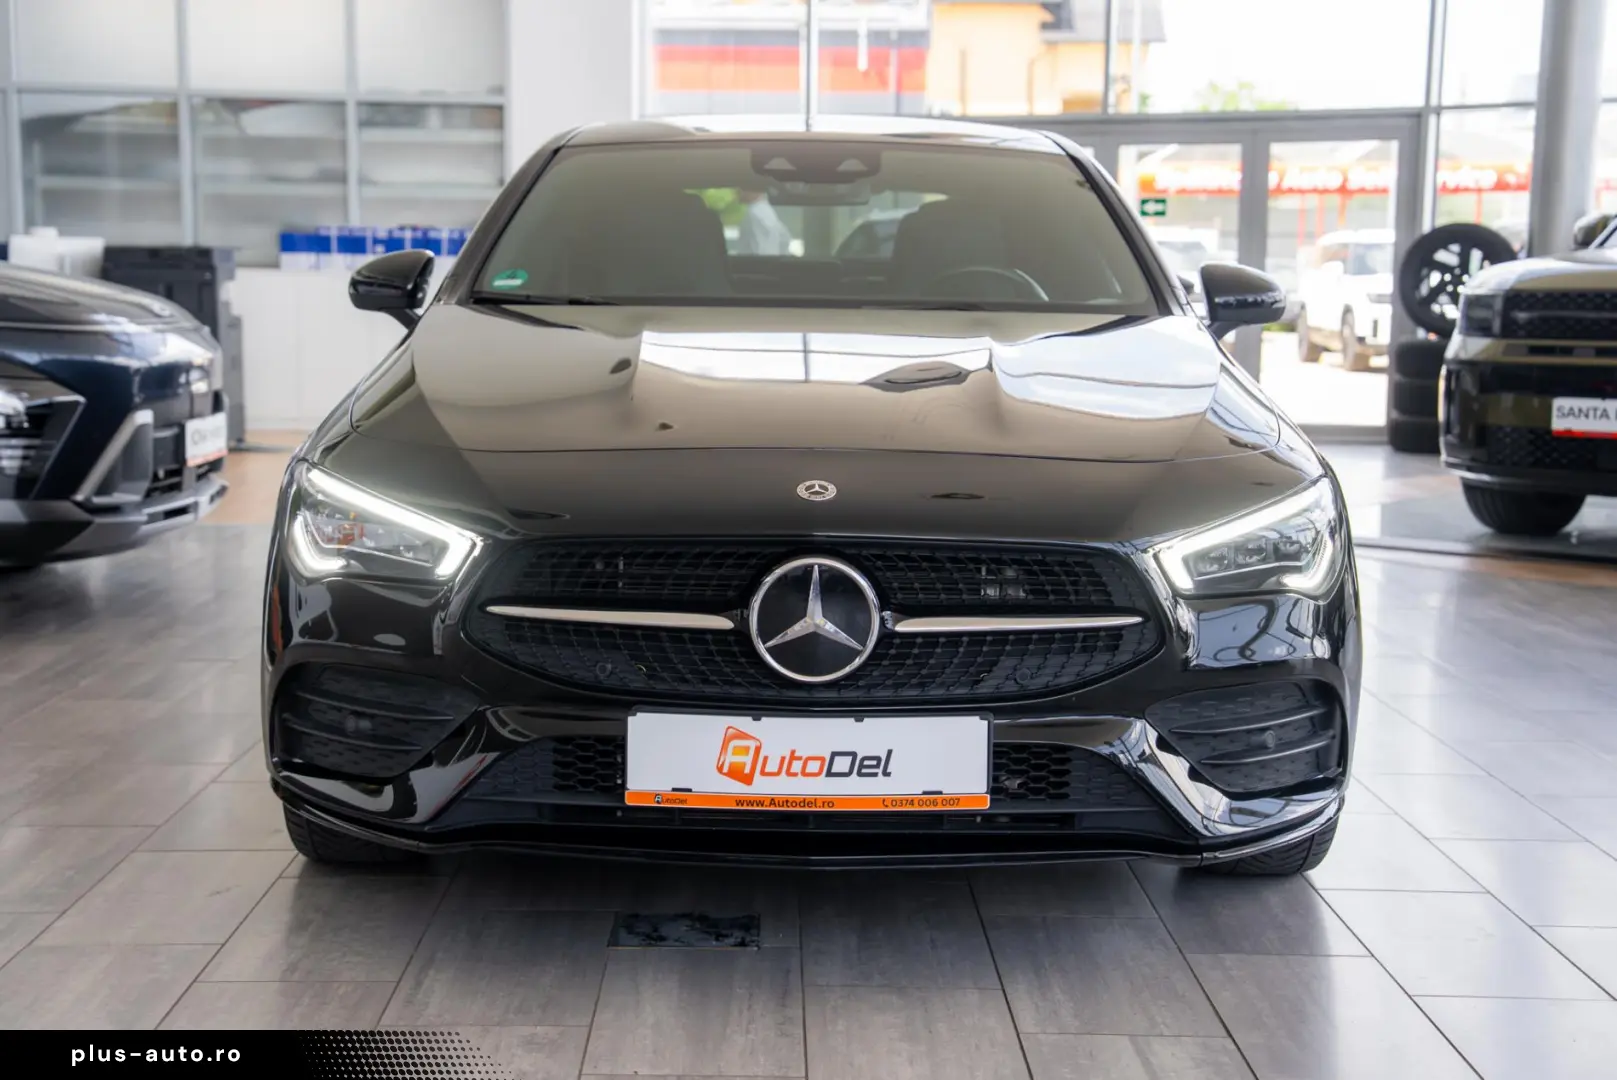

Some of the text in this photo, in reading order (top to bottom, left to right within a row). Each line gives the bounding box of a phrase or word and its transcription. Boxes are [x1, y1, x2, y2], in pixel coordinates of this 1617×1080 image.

[1556, 405, 1611, 420] SANTA
[720, 737, 893, 779] AutoDel
[735, 798, 835, 810] www.Autodel.ro
[890, 798, 915, 808] 0374
[941, 797, 961, 807] 007
